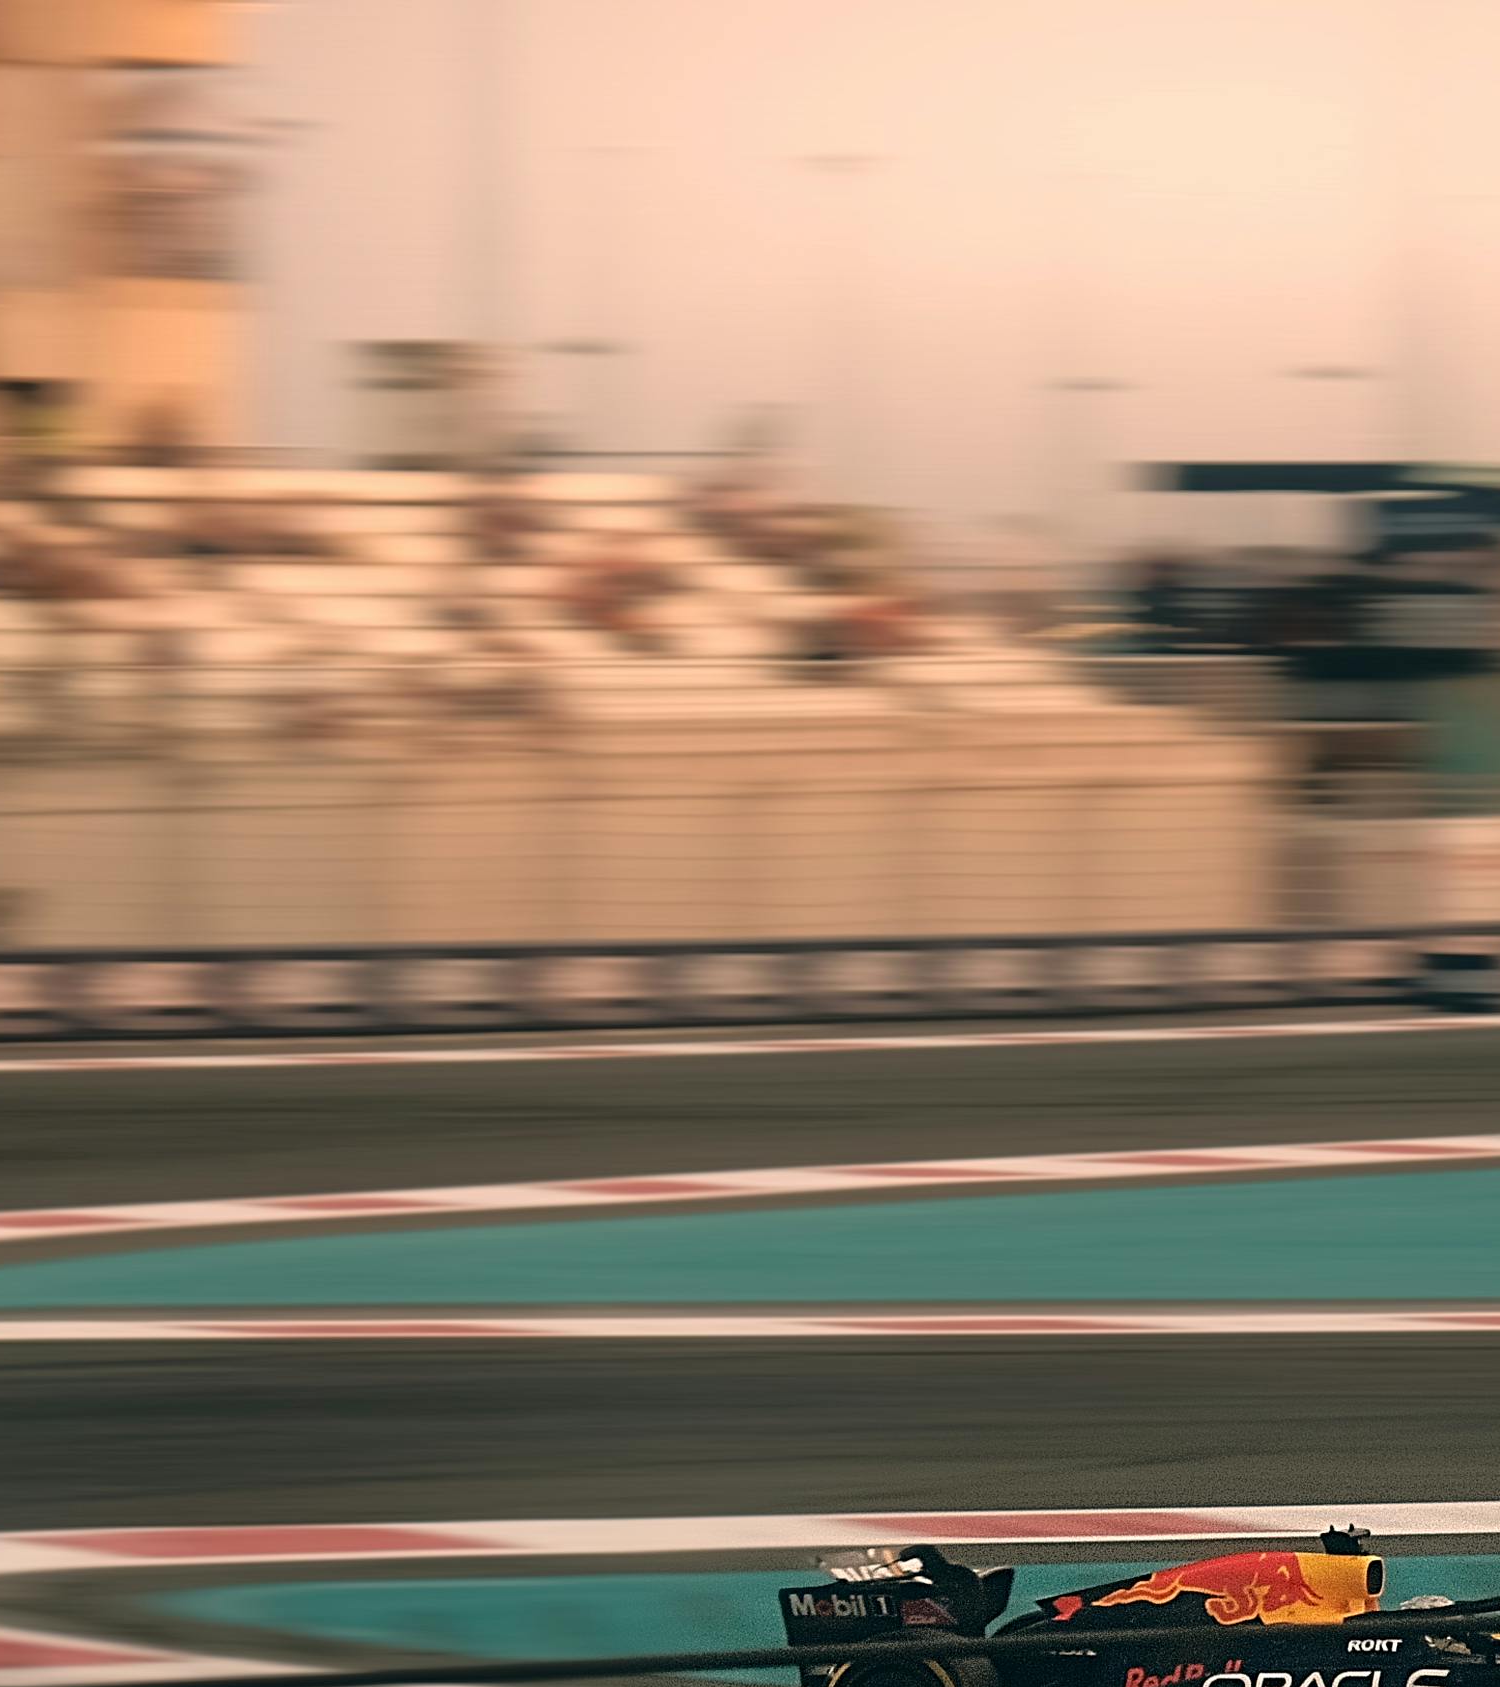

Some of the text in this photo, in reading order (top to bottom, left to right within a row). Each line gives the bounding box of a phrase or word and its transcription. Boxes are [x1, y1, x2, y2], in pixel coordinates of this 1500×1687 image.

[788, 1593, 889, 1617] Mobil 1
[1347, 1638, 1403, 1653] ROKT
